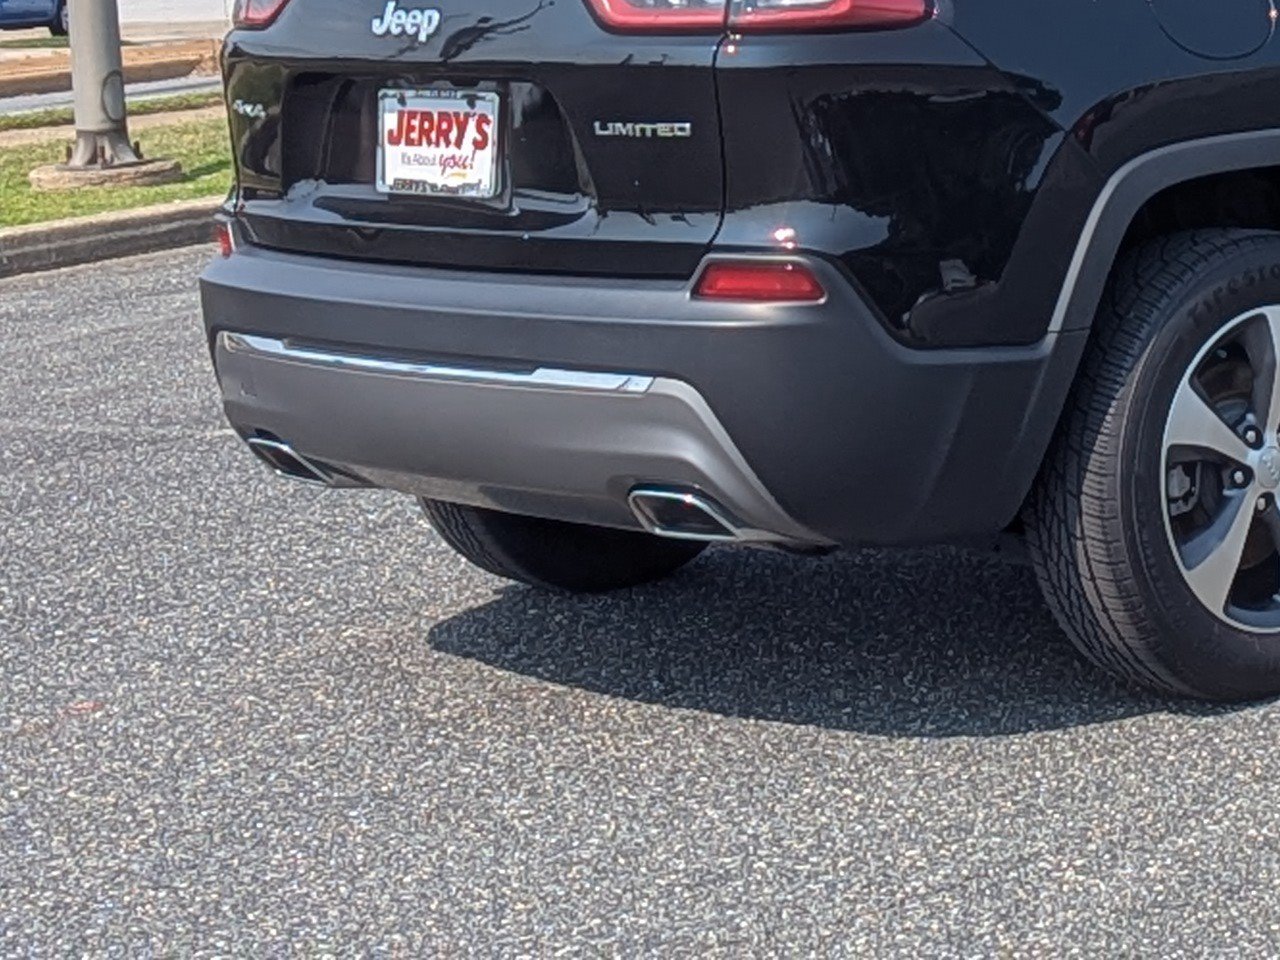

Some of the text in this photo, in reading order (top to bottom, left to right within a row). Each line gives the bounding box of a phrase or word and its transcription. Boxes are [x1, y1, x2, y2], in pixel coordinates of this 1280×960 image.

[371, 0, 441, 43] Jeep
[387, 109, 493, 151] JERRY'S
[593, 120, 692, 138] LIMITED
